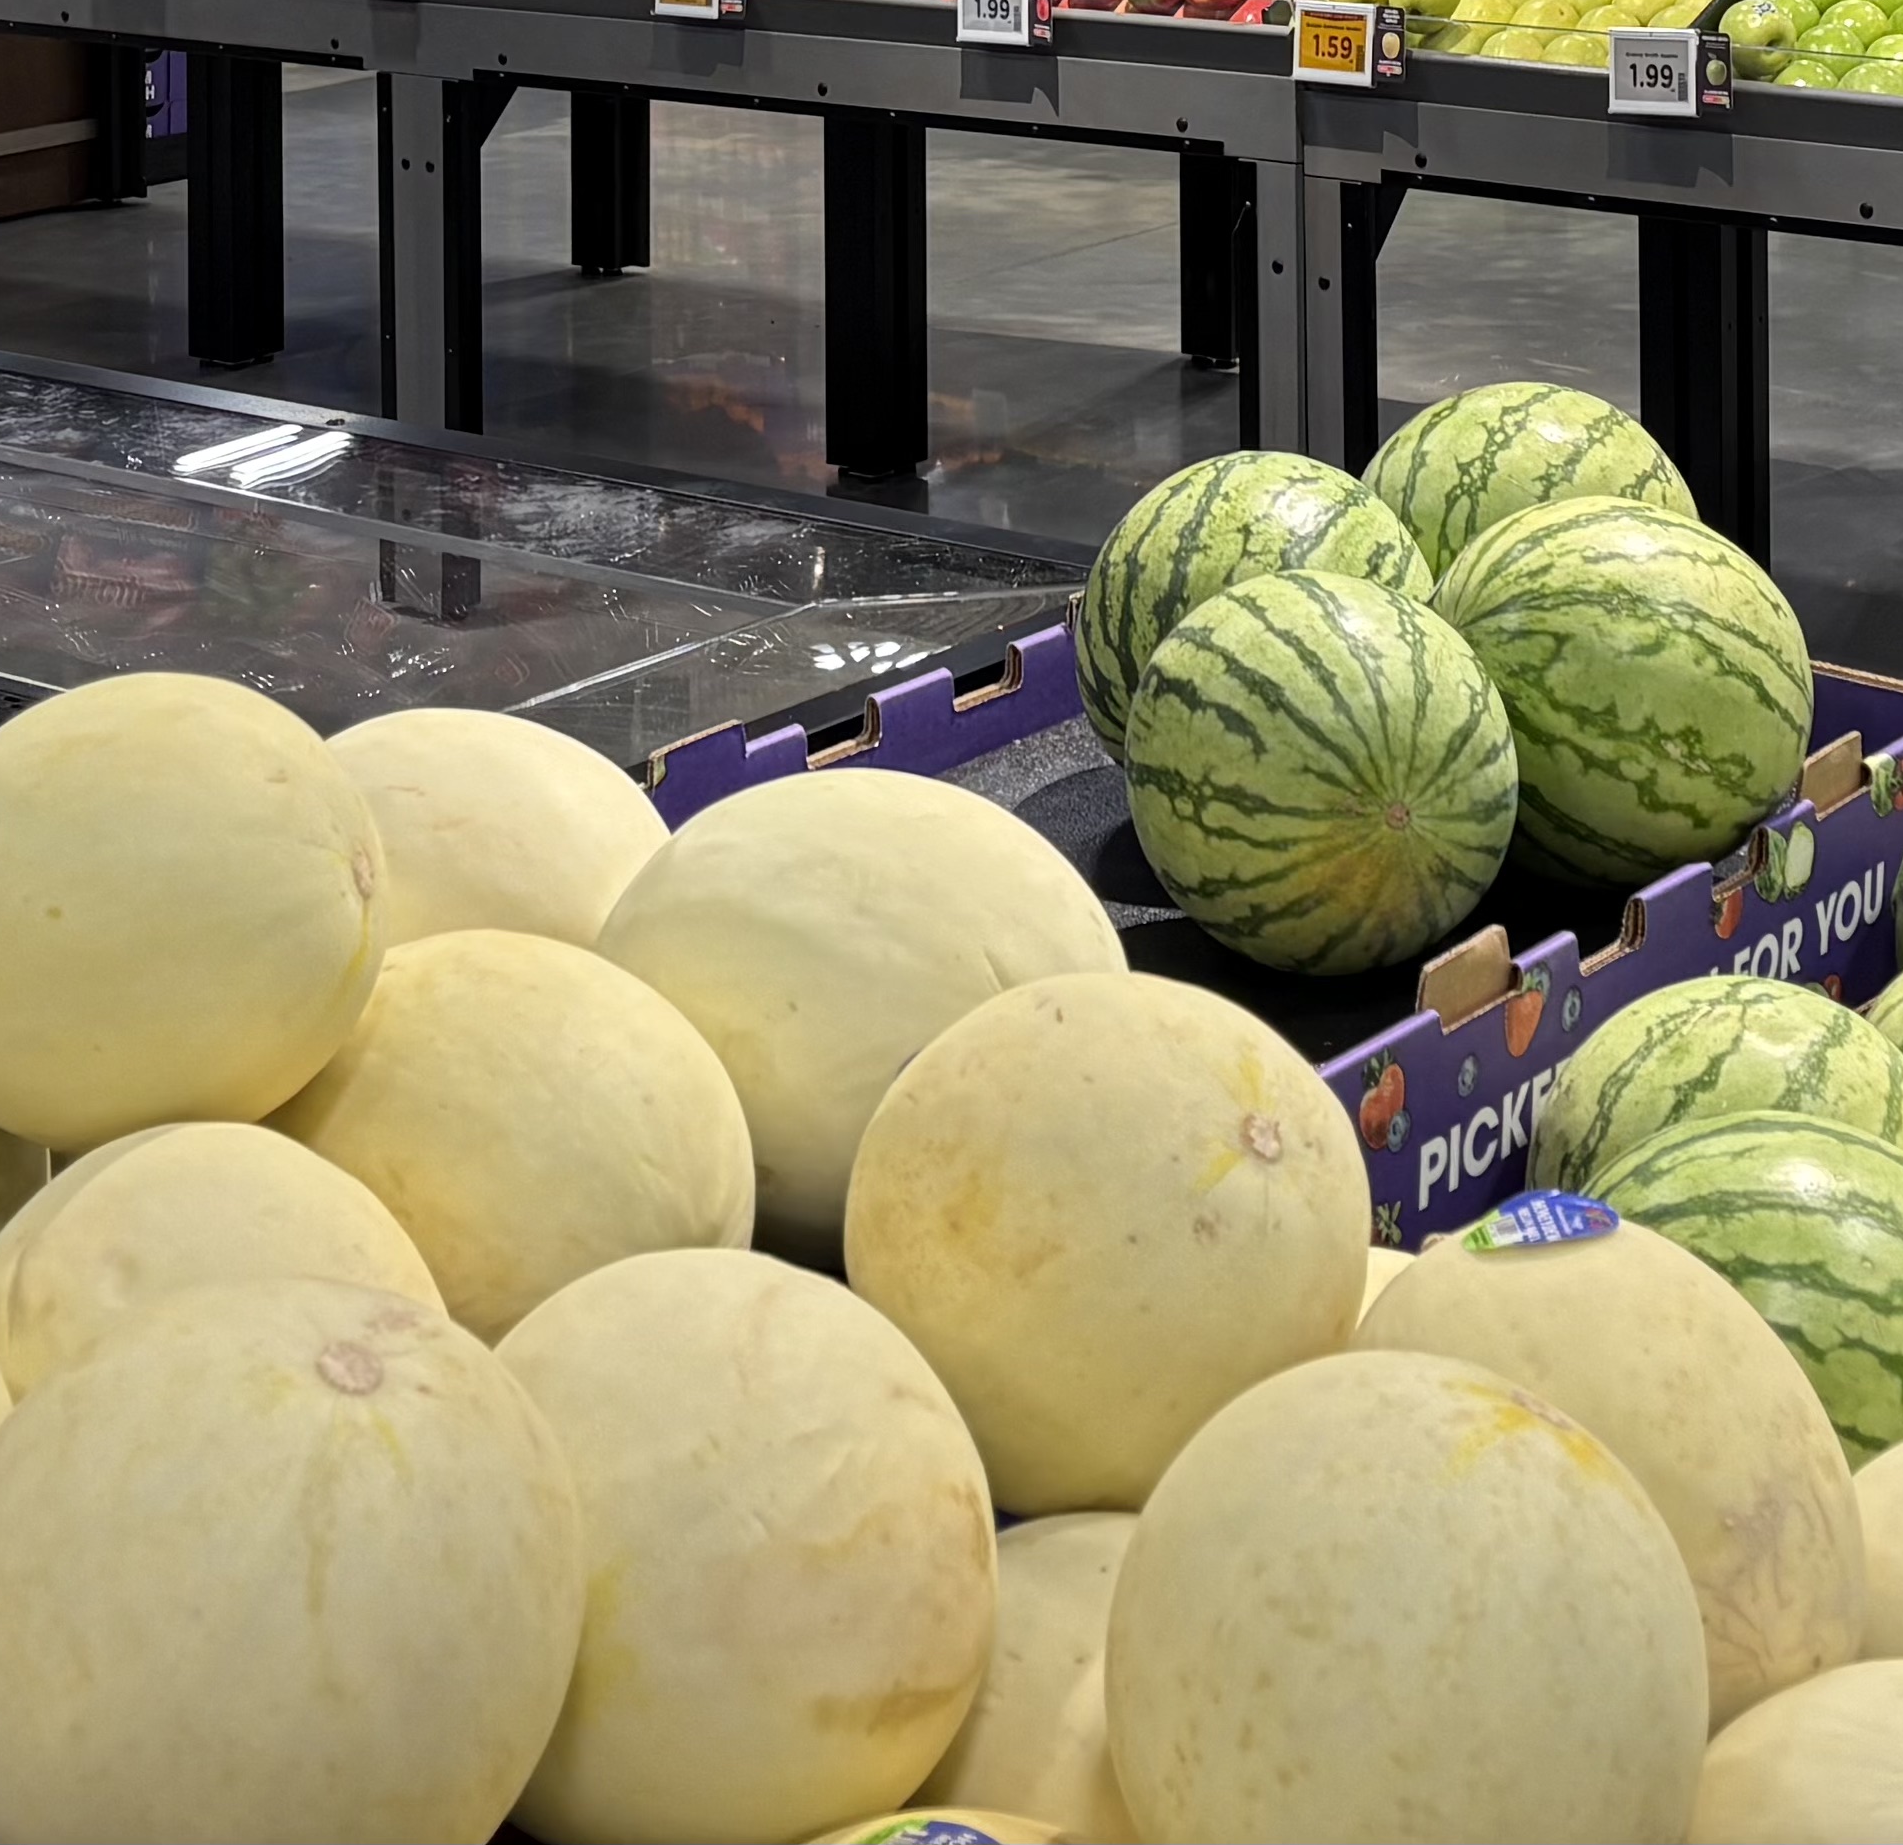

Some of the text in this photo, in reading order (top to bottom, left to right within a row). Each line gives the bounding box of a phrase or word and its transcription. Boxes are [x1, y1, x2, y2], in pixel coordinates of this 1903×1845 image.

[1312, 33, 1353, 59] 1.59
[1629, 63, 1674, 88] 1.99
[1814, 861, 1888, 957] YOU
